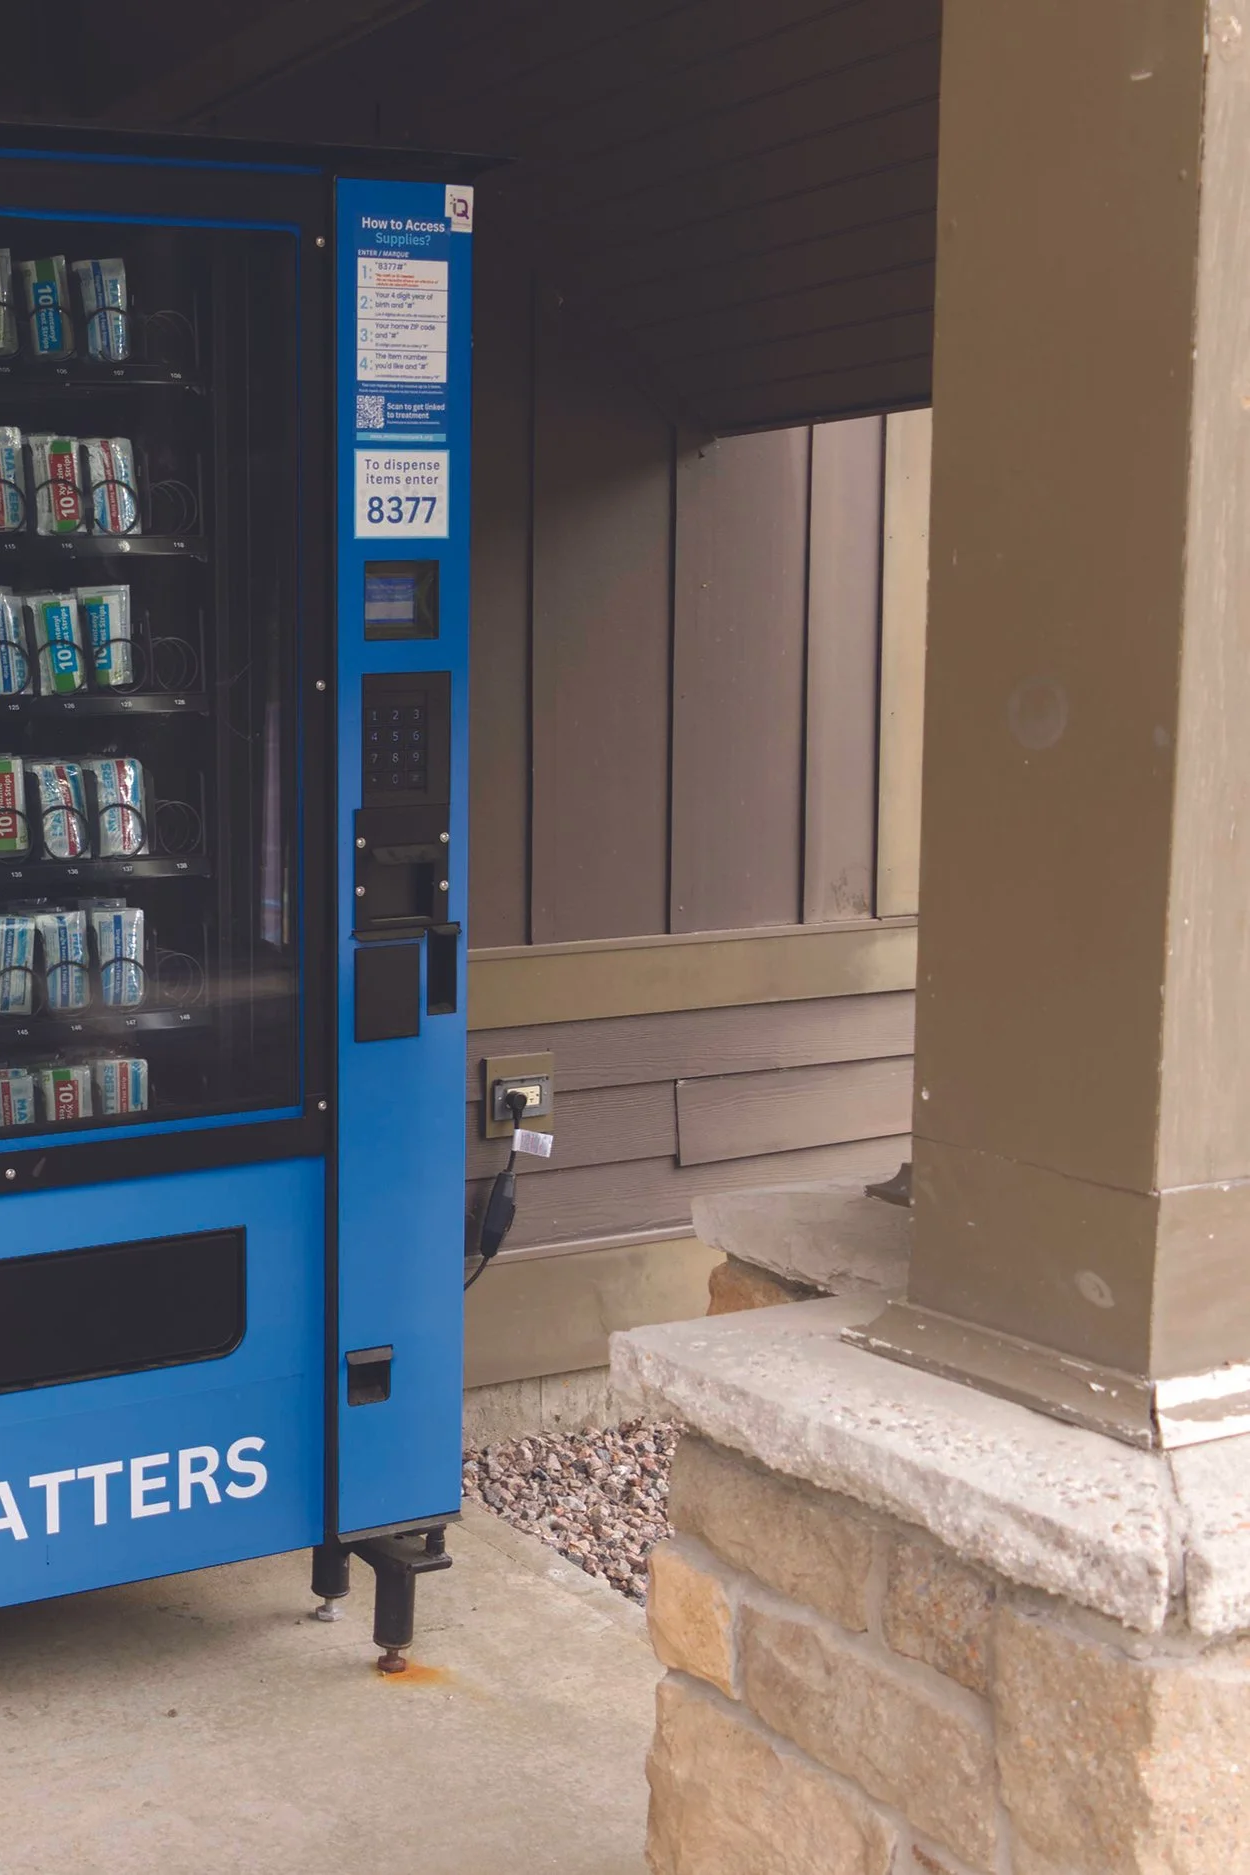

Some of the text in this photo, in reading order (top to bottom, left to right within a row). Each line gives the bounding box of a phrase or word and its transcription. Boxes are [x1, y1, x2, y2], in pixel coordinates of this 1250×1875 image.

[361, 216, 387, 229] How
[390, 219, 403, 231] to
[405, 219, 445, 233] Access
[375, 232, 431, 247] Supplies?
[357, 249, 378, 257] ENTER
[383, 250, 409, 258] MARQUE
[37, 284, 54, 306] 10
[375, 292, 389, 300] Your
[391, 292, 396, 300] 4
[396, 292, 410, 301] digit
[411, 293, 425, 301] year
[375, 301, 390, 309] birth
[391, 301, 404, 309] and
[375, 323, 389, 331] Your
[391, 323, 409, 331] home
[375, 331, 388, 339] and
[403, 353, 427, 361] number
[375, 362, 392, 371] you'd
[387, 402, 445, 412] Scan to get linked
[387, 411, 430, 419] to treatment
[63, 454, 72, 477] Strips
[364, 459, 440, 472] To dispense
[56, 464, 67, 496] Xylzine
[366, 473, 438, 485] items enter
[60, 496, 76, 518] 10
[367, 496, 437, 524] 8377
[60, 608, 68, 630] Strips
[98, 606, 107, 645] Test Strips
[52, 615, 62, 648] Fntanyl
[90, 612, 99, 646] Fentanyl
[56, 650, 74, 670] 10
[4, 774, 12, 796] Strips
[59, 1084, 74, 1103] 10
